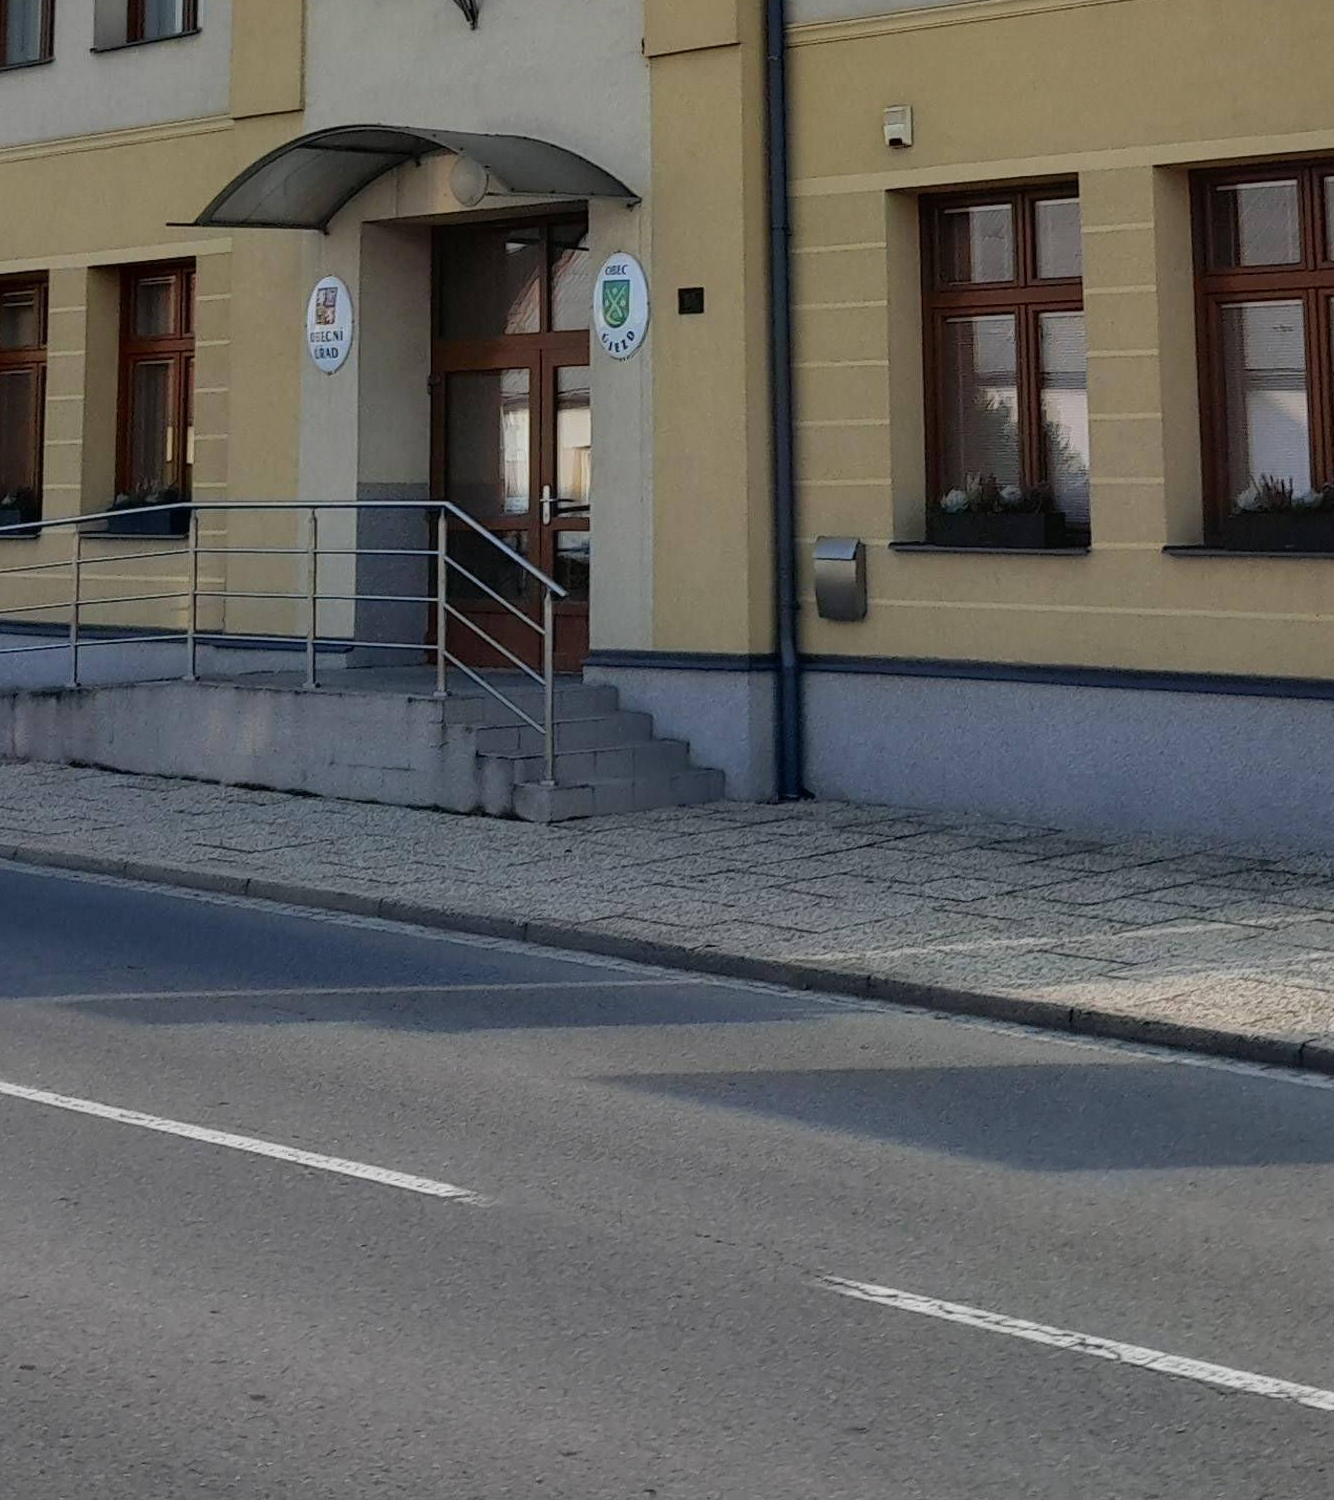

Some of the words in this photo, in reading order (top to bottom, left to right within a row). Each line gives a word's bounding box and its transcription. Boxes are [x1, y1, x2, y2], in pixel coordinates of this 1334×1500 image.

[604, 263, 629, 276] OBEC
[309, 326, 344, 343] OBECNÍ
[600, 330, 636, 353] ÚJEZD
[314, 344, 340, 360] ÚŘAD
